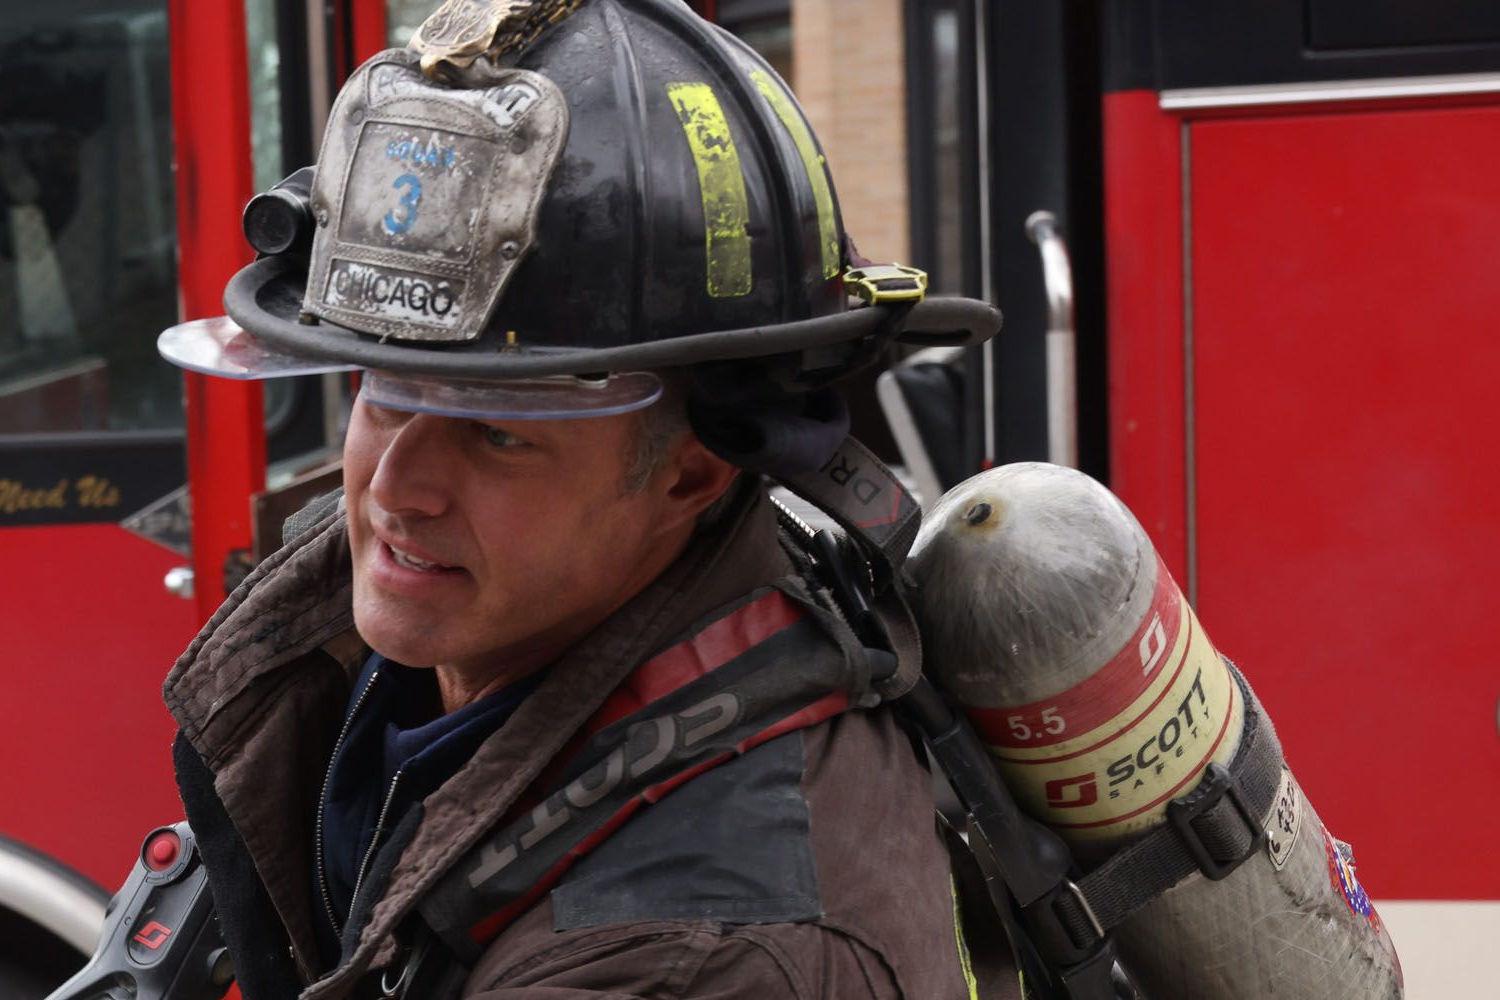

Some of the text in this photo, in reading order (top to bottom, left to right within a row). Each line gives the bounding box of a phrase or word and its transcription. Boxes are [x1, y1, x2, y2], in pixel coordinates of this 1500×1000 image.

[384, 173, 423, 235] 3
[335, 266, 454, 316] CHICAGO
[76, 474, 120, 508] Us
[1007, 706, 1067, 741] 5.5
[1106, 666, 1207, 787] SCOTT
[1109, 706, 1210, 800] SAFETY
